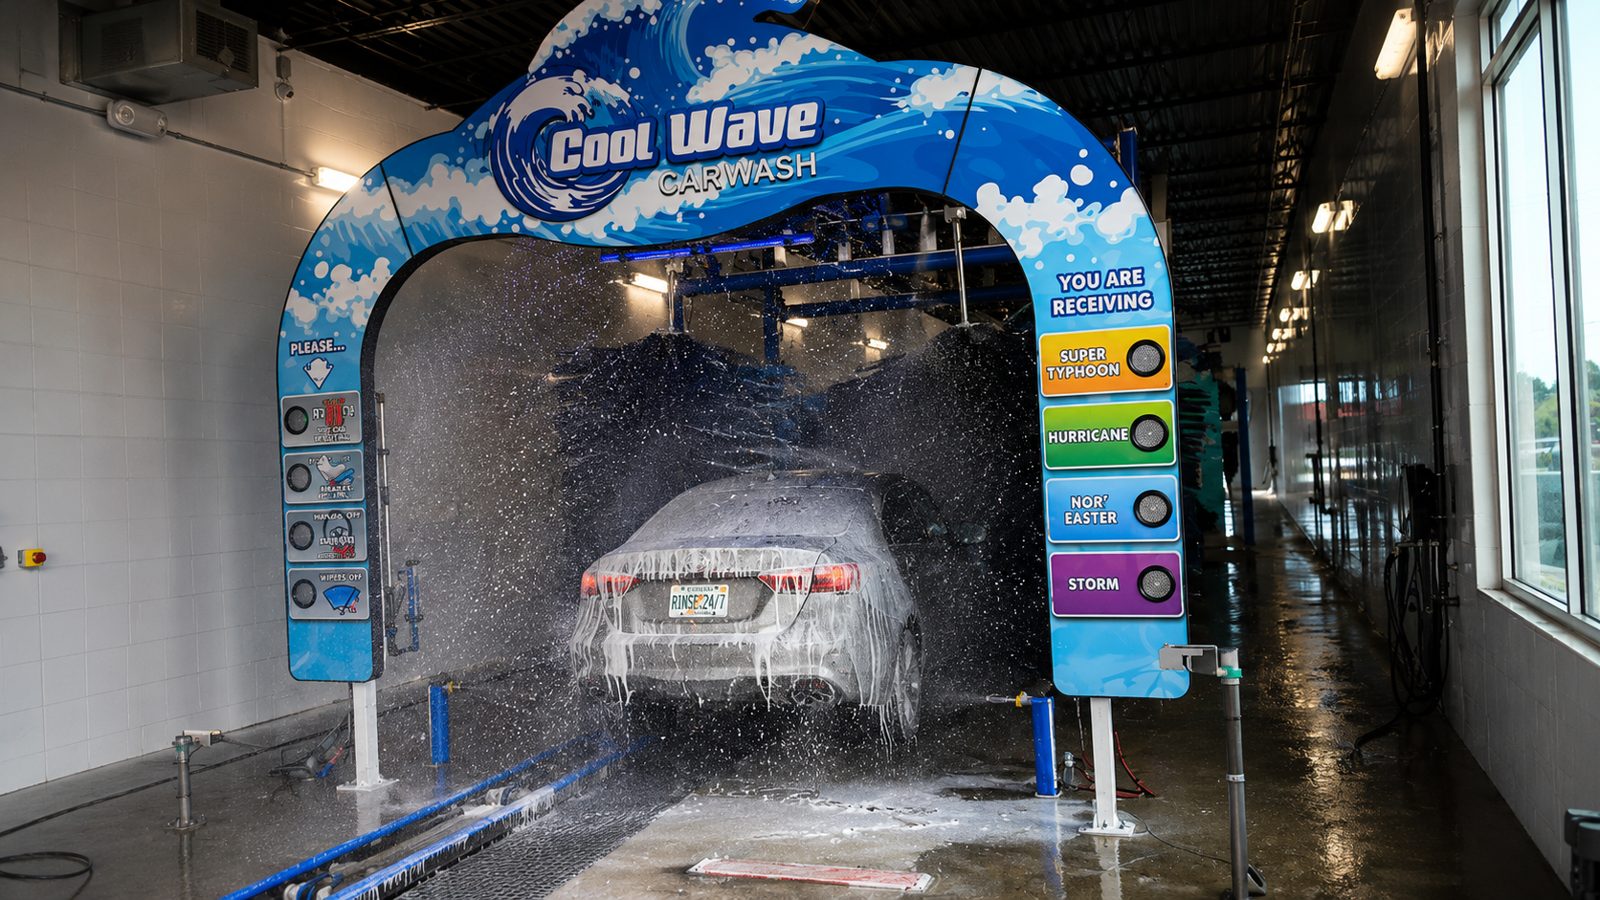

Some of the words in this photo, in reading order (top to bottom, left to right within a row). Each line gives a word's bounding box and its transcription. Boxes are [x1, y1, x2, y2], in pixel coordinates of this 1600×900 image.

[549, 121, 654, 173] Cool
[669, 101, 819, 156] Wave
[658, 151, 818, 196] CARWASH
[1057, 272, 1101, 292] YOU
[1105, 268, 1144, 288] ARE
[1052, 292, 1153, 316] RECEIVING
[290, 339, 346, 356] PLEASE...
[1059, 347, 1106, 363] SUPER
[1046, 362, 1120, 380] TYPHOON
[1048, 428, 1129, 444] HURRICANE
[1071, 494, 1109, 509] NOR'
[1064, 511, 1118, 525] EASTER
[1068, 577, 1120, 591] STORM
